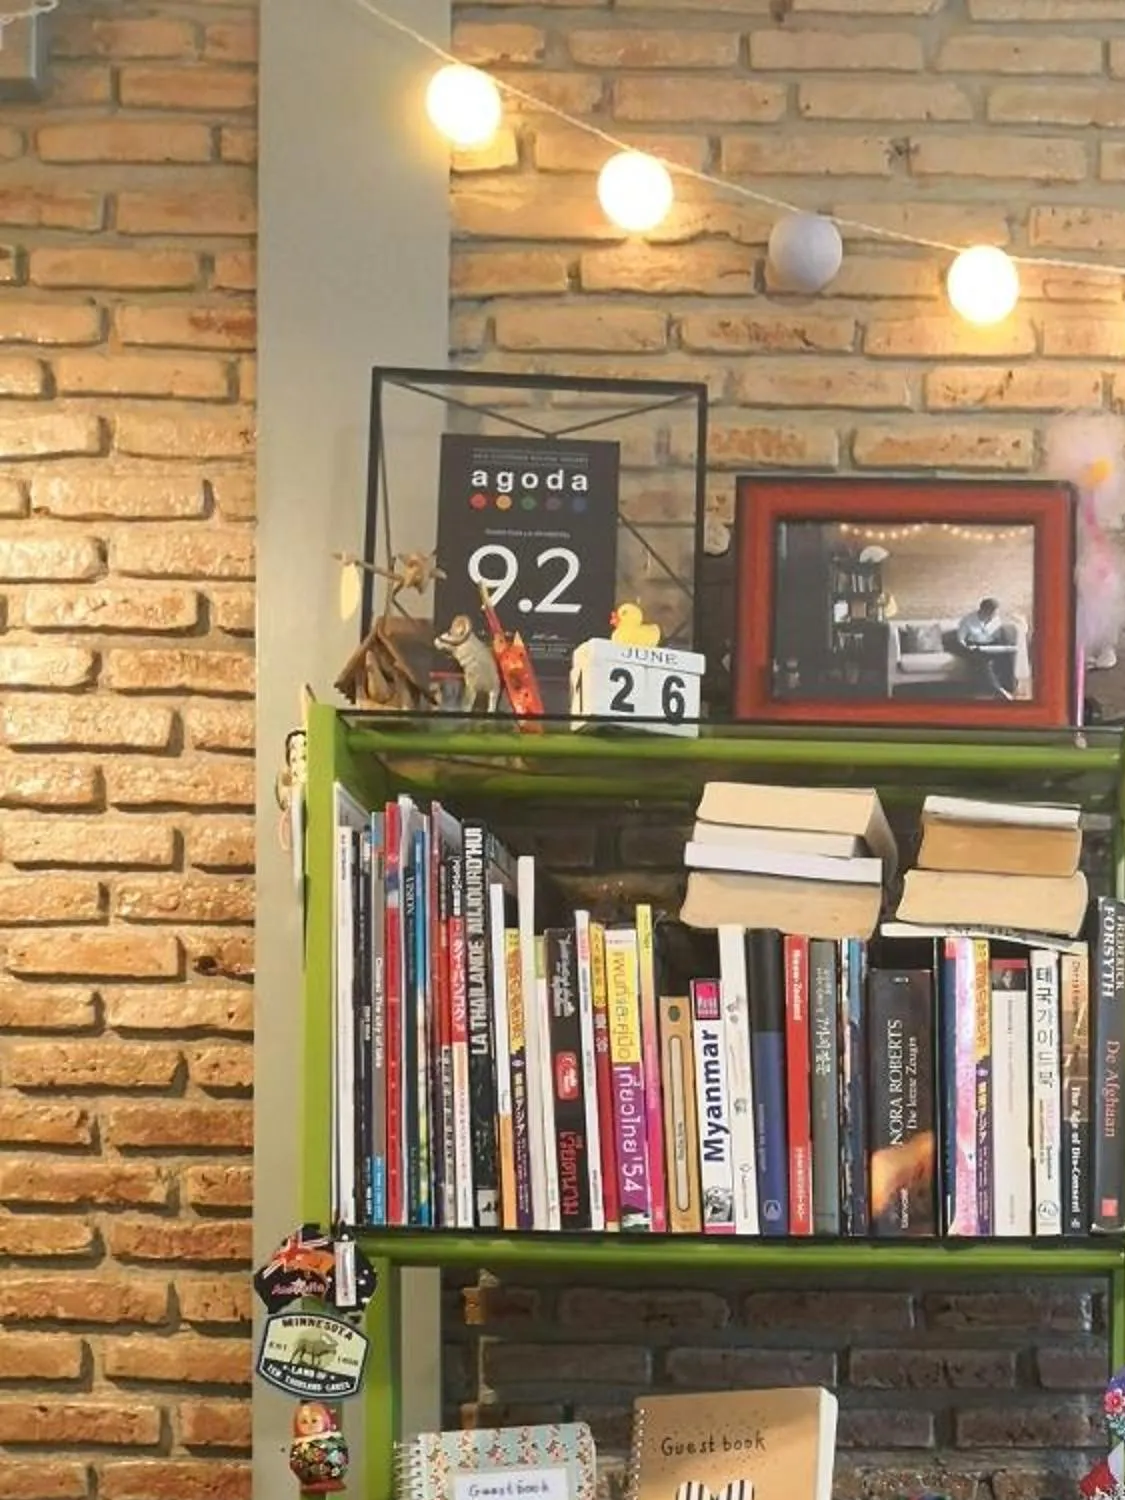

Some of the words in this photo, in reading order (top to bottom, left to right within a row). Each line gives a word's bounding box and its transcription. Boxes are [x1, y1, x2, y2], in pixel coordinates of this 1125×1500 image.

[472, 469, 588, 492] agoda
[468, 544, 582, 613] 9.2
[619, 649, 678, 665] JUNE
[1101, 905, 1116, 997] FORSYTH
[1115, 915, 1125, 990] FREDERICK
[471, 1034, 488, 1054] LA
[887, 1020, 903, 1093] ROBERTS
[1106, 1040, 1119, 1065] De
[700, 1029, 729, 1162] Myanmar
[888, 1096, 906, 1145] NORA
[1103, 1071, 1119, 1138] Afghaan
[281, 1317, 353, 1341] MINNESOTA
